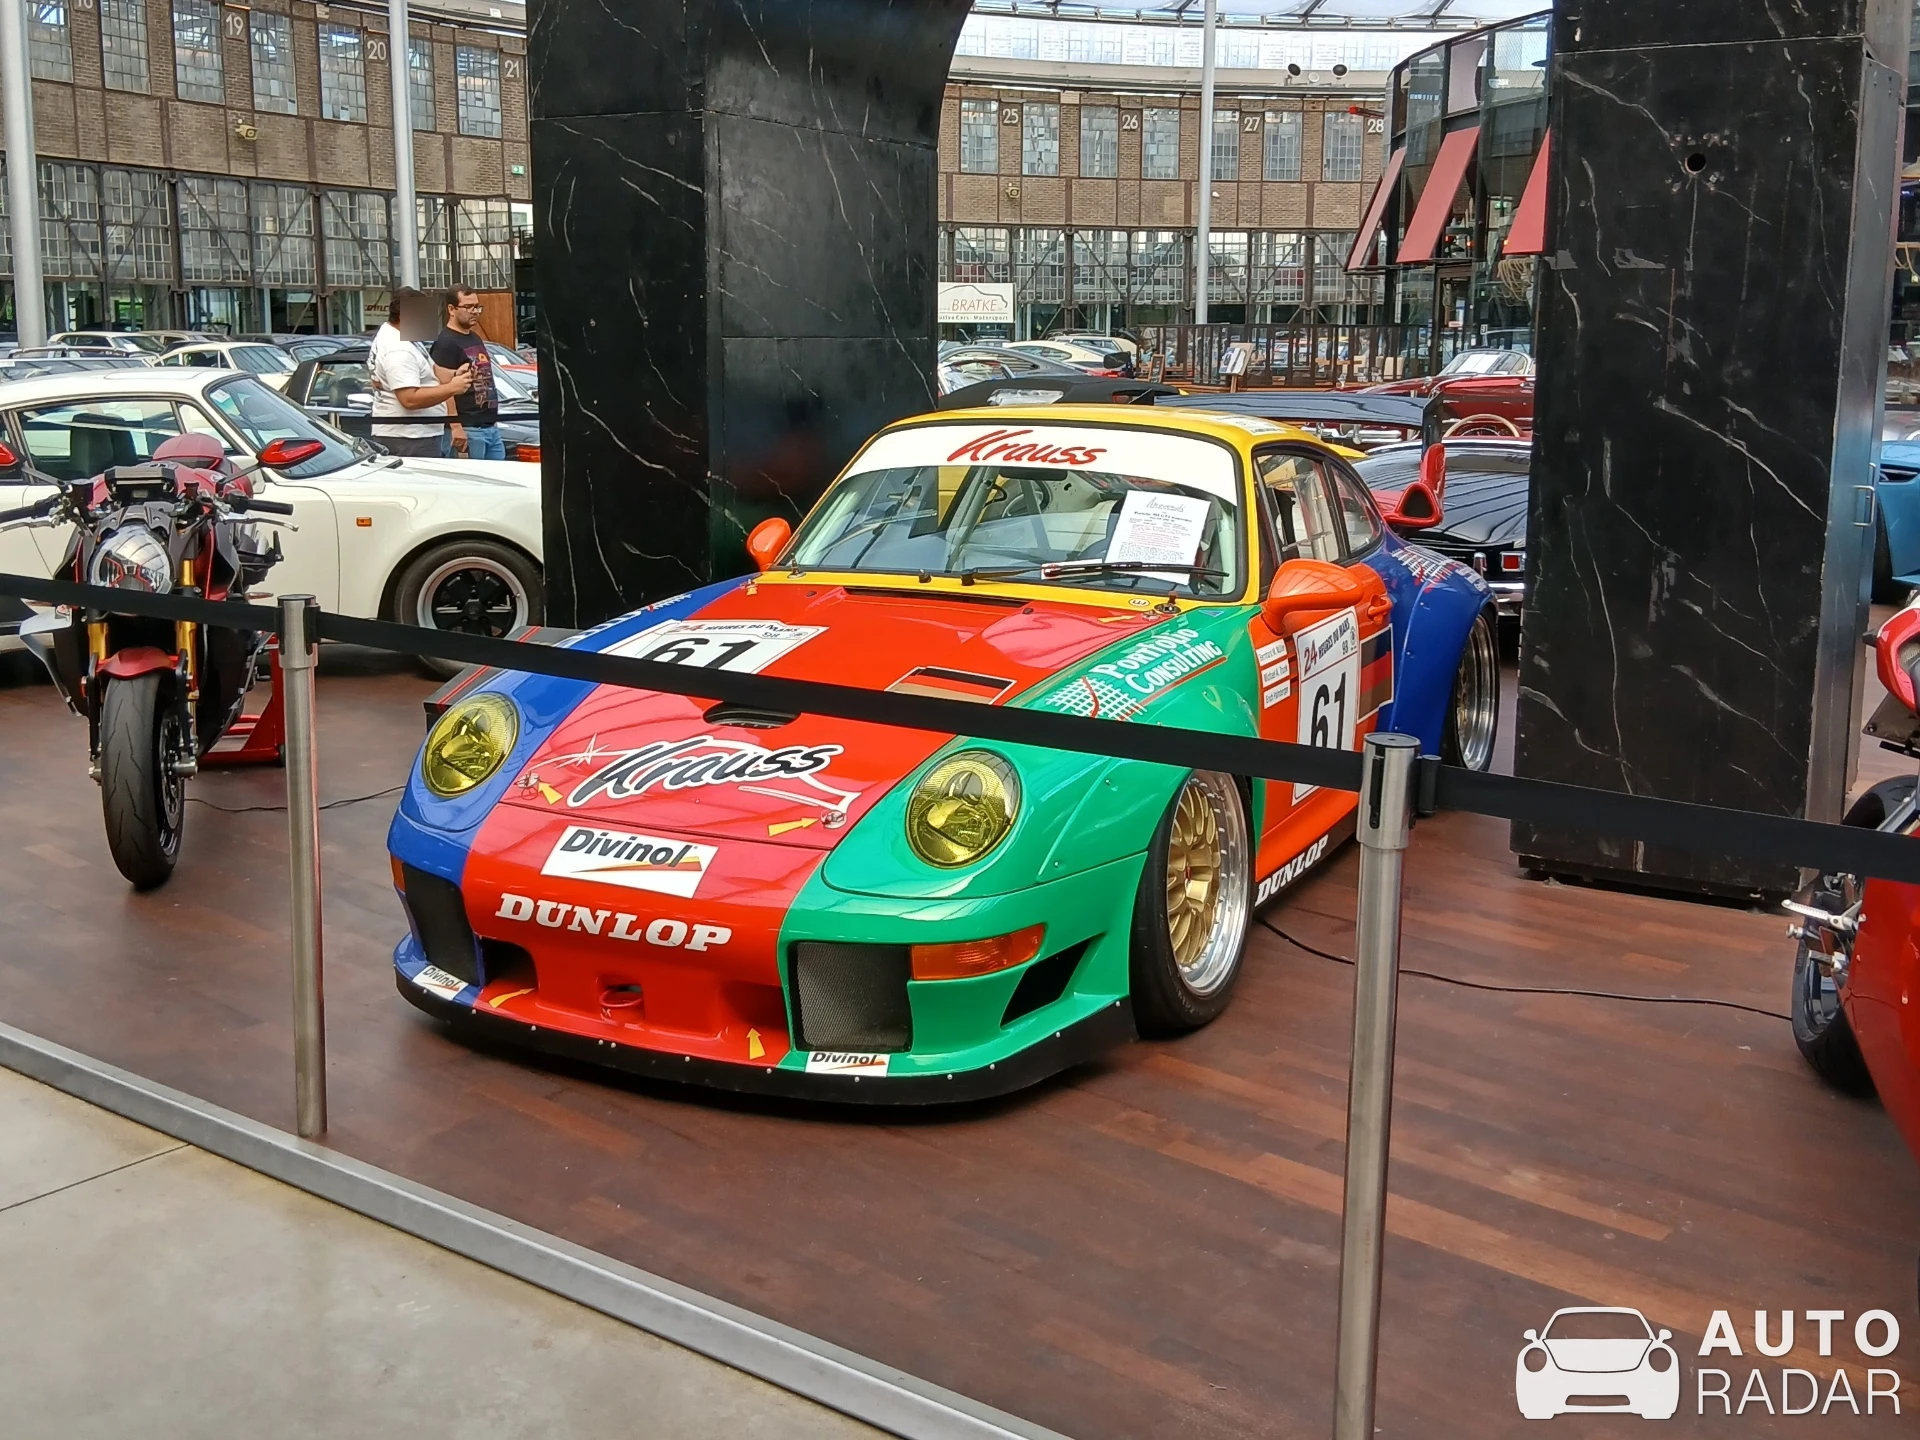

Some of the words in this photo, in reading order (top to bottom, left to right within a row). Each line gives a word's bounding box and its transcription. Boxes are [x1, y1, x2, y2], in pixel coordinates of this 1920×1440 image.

[225, 13, 244, 36] 19
[366, 40, 387, 61] 20
[504, 59, 520, 79] 21
[1002, 108, 1019, 124] 25
[1122, 114, 1139, 130] 26
[1244, 116, 1260, 132] 27
[1367, 118, 1385, 133] 28
[951, 298, 998, 312] BRATKE
[946, 429, 1108, 465] Krauss
[667, 623, 706, 633] 24
[1303, 639, 1318, 677] 24
[1317, 634, 1334, 660] HEURES
[1338, 616, 1350, 639] MANS
[1311, 671, 1346, 750] 61
[568, 736, 843, 806] Krauss
[560, 829, 694, 868] Divinol
[1254, 833, 1329, 908] DUNLOP
[494, 892, 732, 953] DUNLOP
[422, 966, 460, 990] Divinol
[810, 1052, 878, 1065] Divinol
